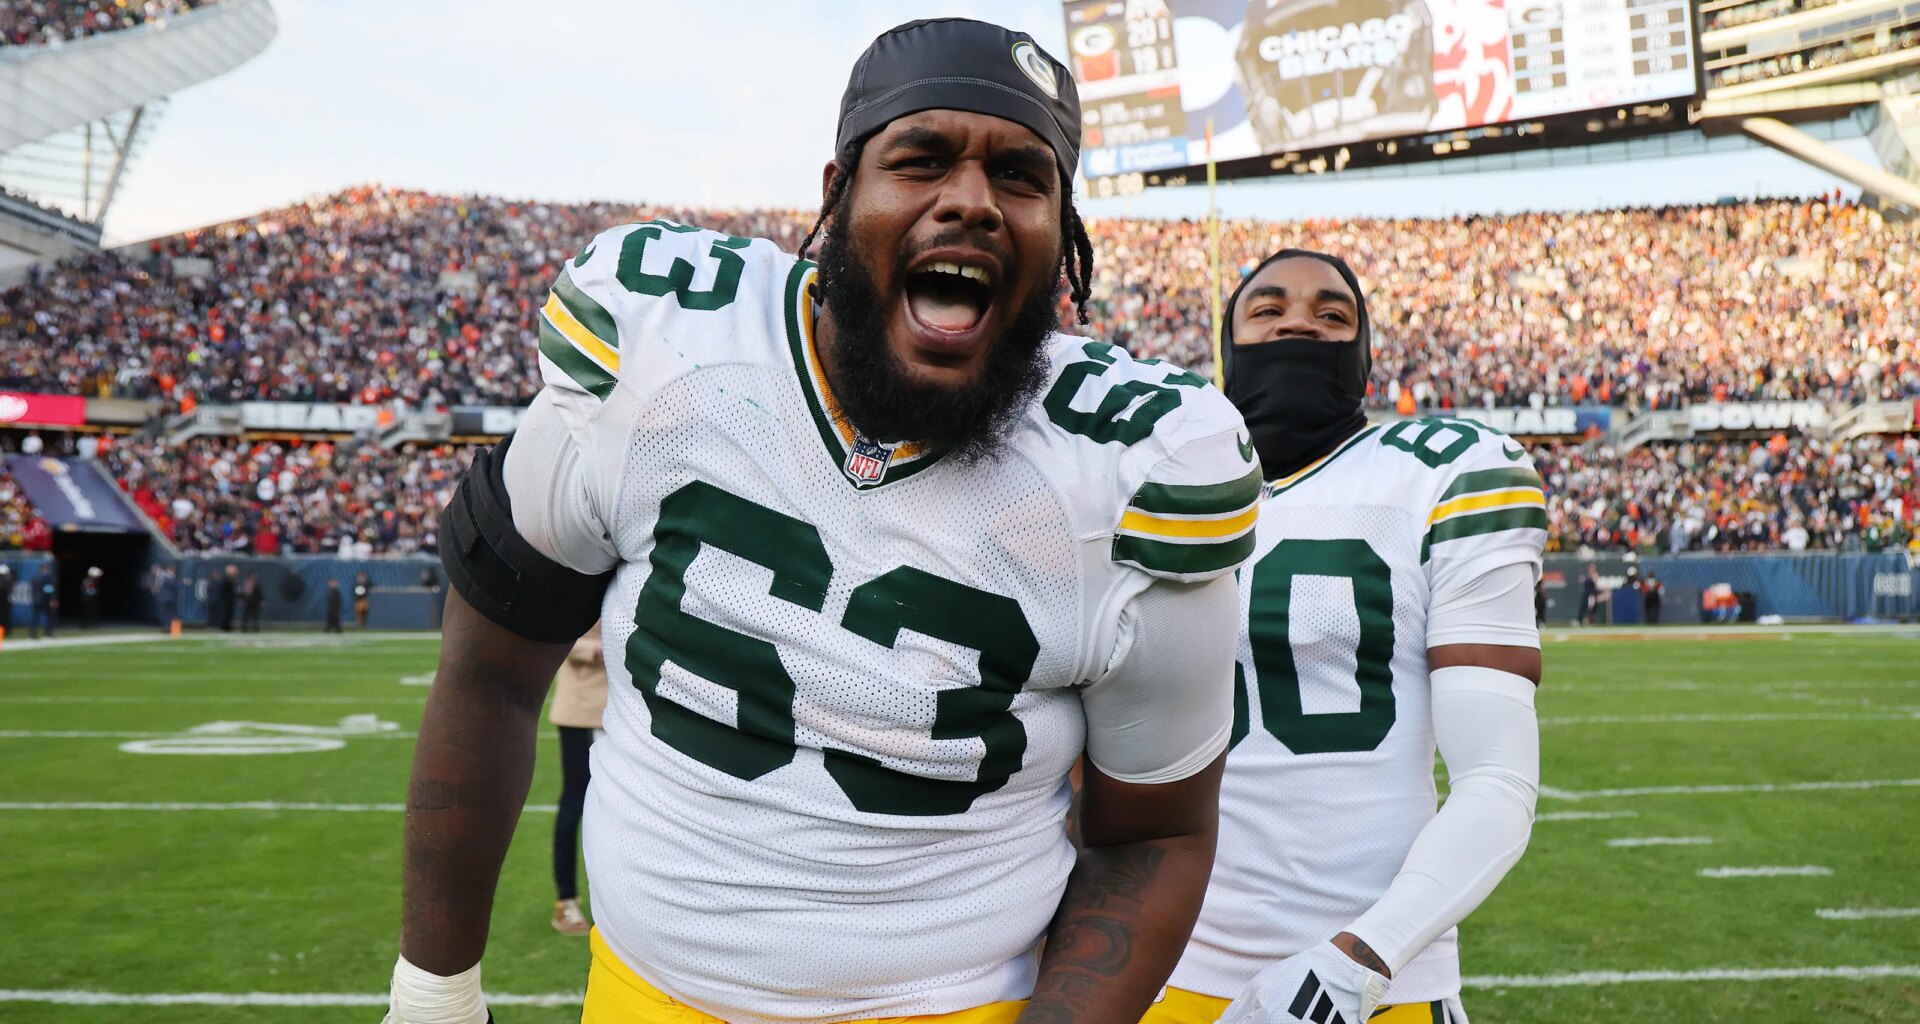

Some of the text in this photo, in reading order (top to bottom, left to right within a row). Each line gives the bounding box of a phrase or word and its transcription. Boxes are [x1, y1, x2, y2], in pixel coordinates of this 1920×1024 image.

[1259, 13, 1412, 62] CHICAGO
[1690, 403, 1824, 431] DOWN
[850, 454, 880, 479] NFL
[624, 479, 1041, 817] 63
[1229, 537, 1397, 756] 0
